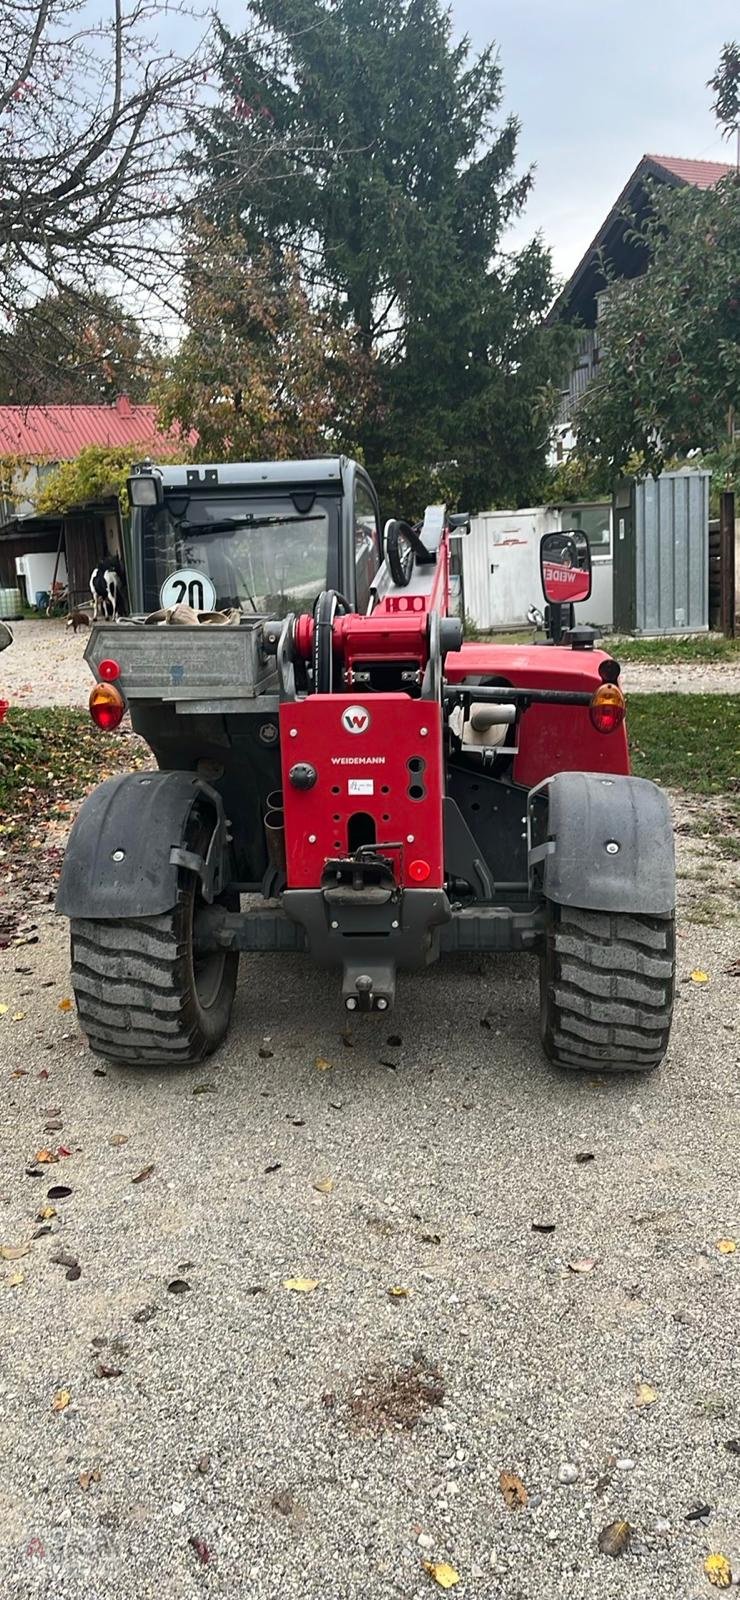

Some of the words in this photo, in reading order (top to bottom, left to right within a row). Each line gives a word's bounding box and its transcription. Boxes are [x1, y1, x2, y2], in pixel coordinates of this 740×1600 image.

[172, 579, 204, 611] 20
[345, 716, 366, 728] W
[331, 757, 385, 765] WEIDEMANN
